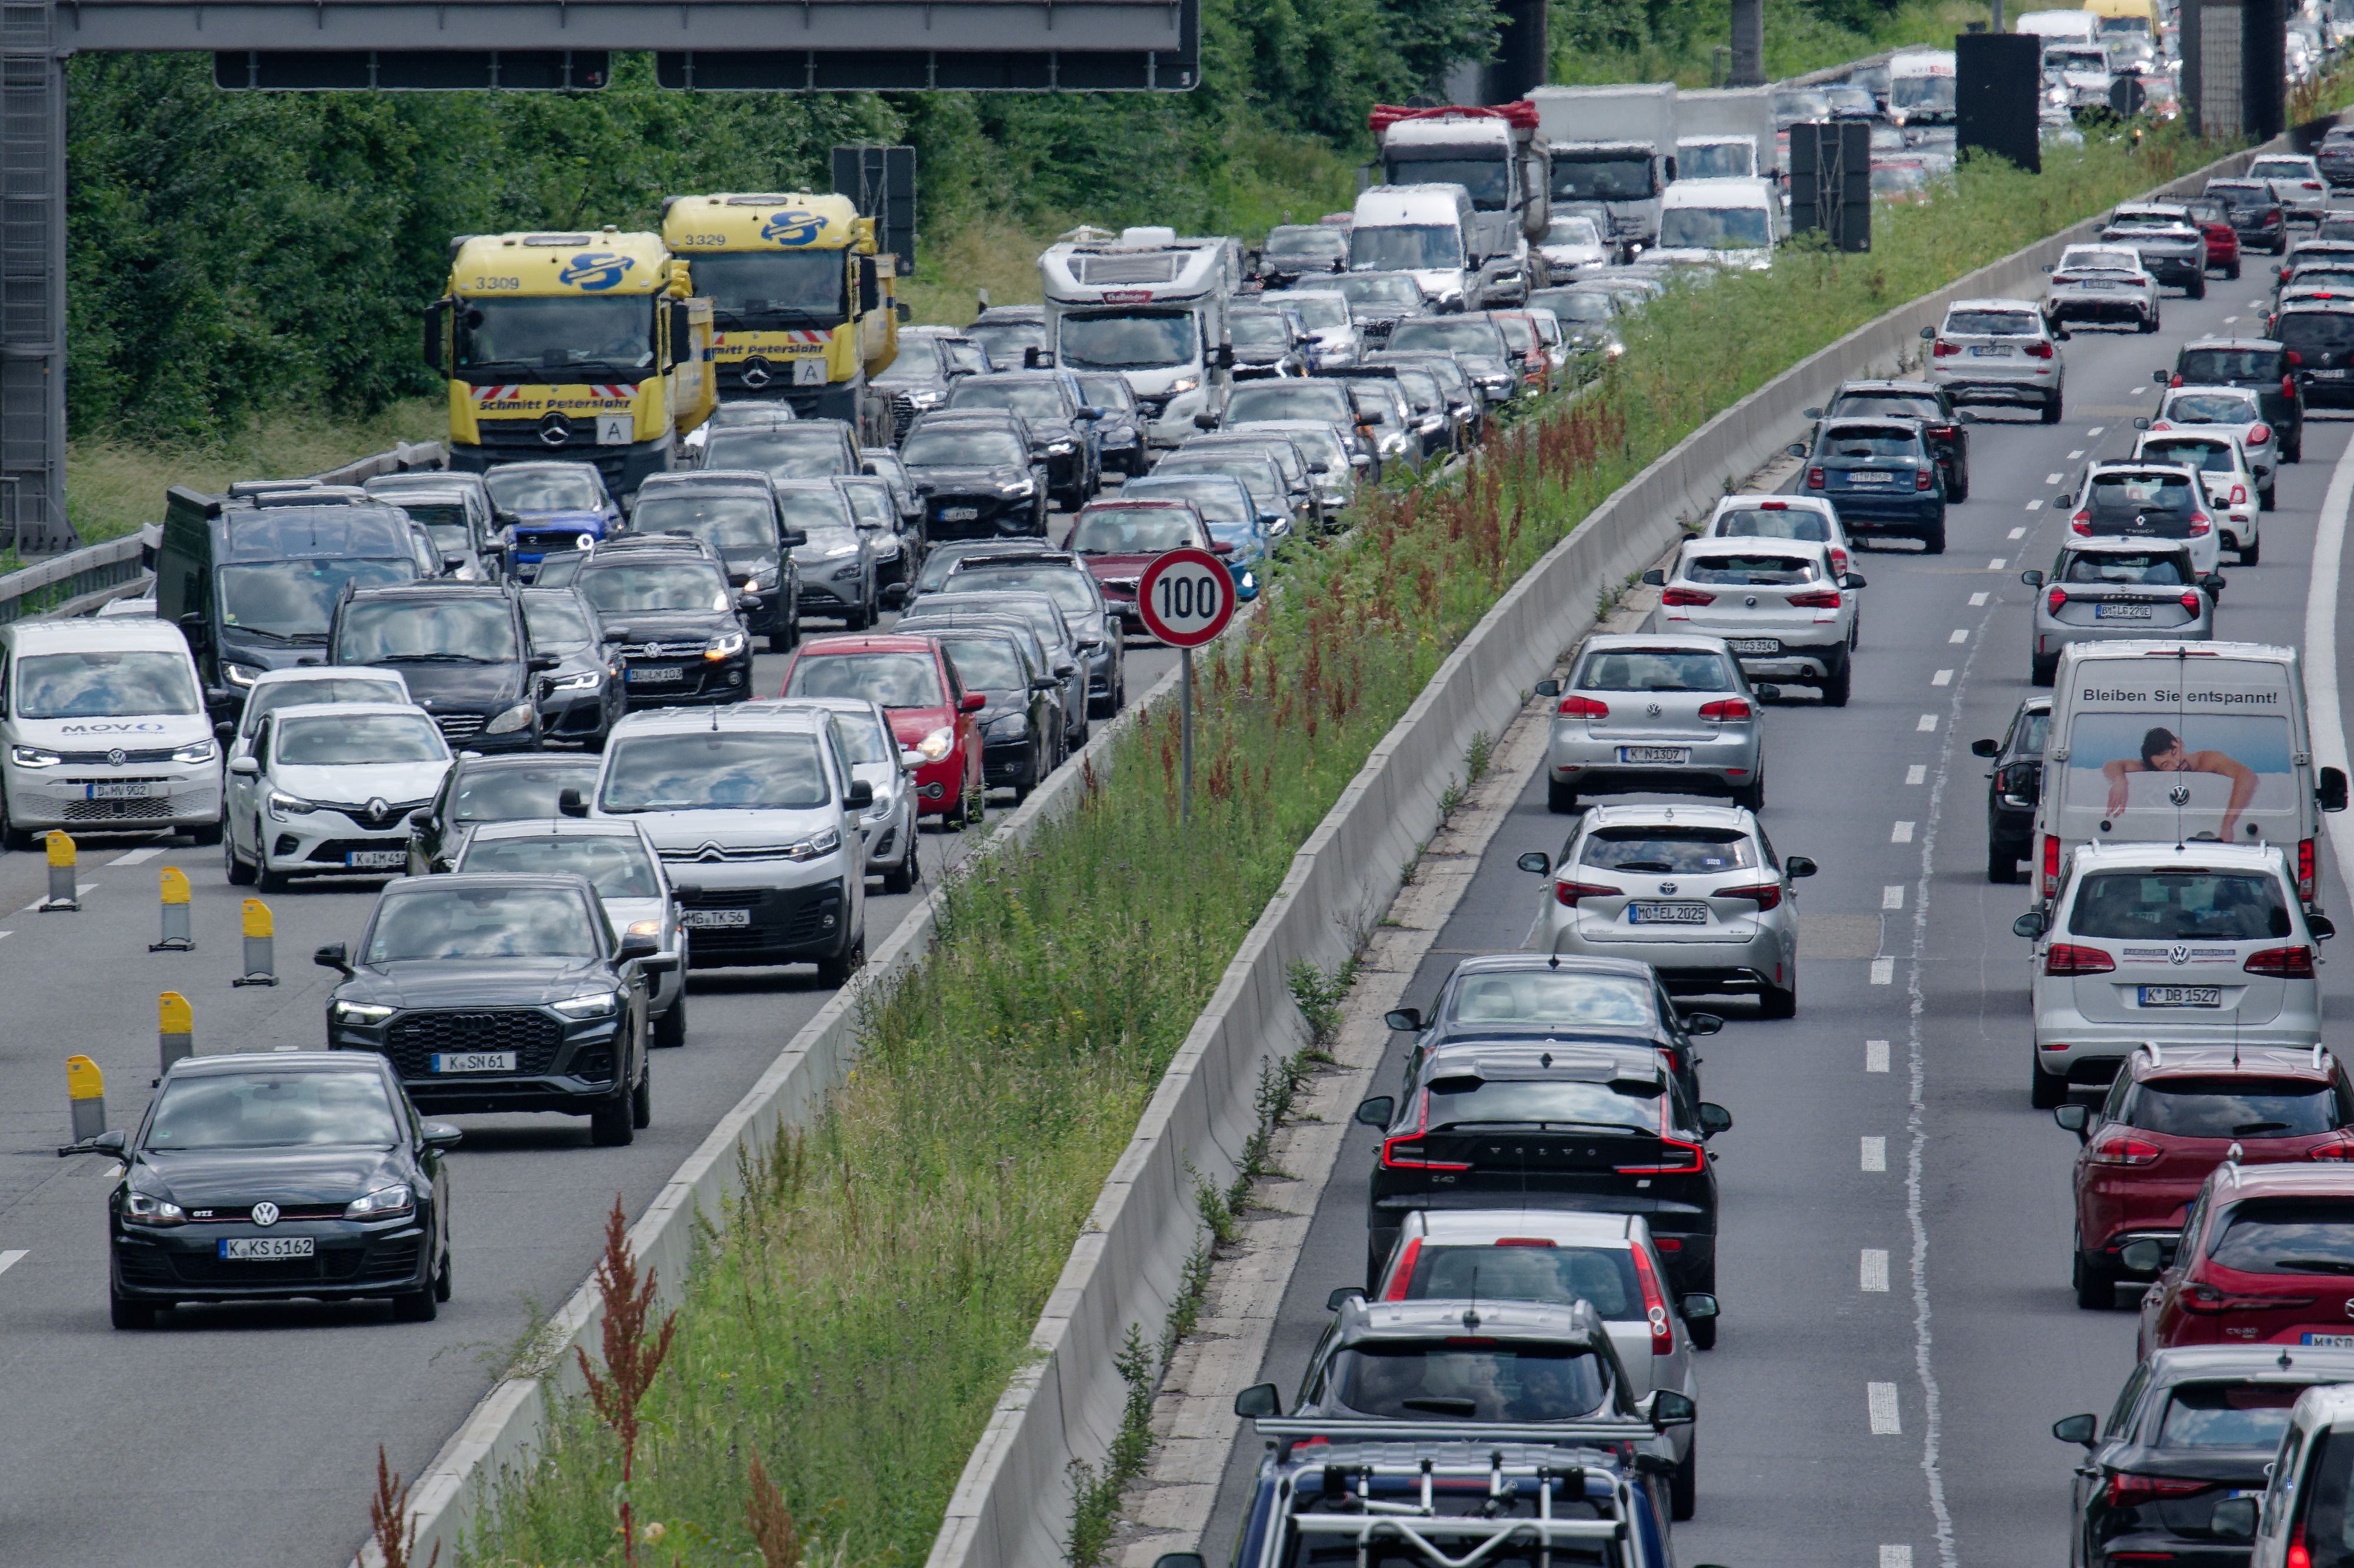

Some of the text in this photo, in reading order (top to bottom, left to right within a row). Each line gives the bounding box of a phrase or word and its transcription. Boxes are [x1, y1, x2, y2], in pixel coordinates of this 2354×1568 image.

[685, 234, 726, 246] 3329
[475, 277, 520, 290] 3309
[804, 364, 818, 381] A
[479, 398, 632, 411] Schmitt Peterslahr
[607, 421, 622, 440] A
[1159, 576, 1216, 618] 100
[2083, 689, 2278, 705] Bleiben Sie entspannt!
[711, 911, 726, 924] TK
[729, 911, 744, 923] 56
[1638, 907, 1705, 920] MO EL 2025
[2148, 989, 2218, 1002] K DB 1527
[449, 1054, 505, 1070] K SN 61
[1489, 1147, 1597, 1156] VOLVO
[229, 1239, 312, 1256] K KS 6162
